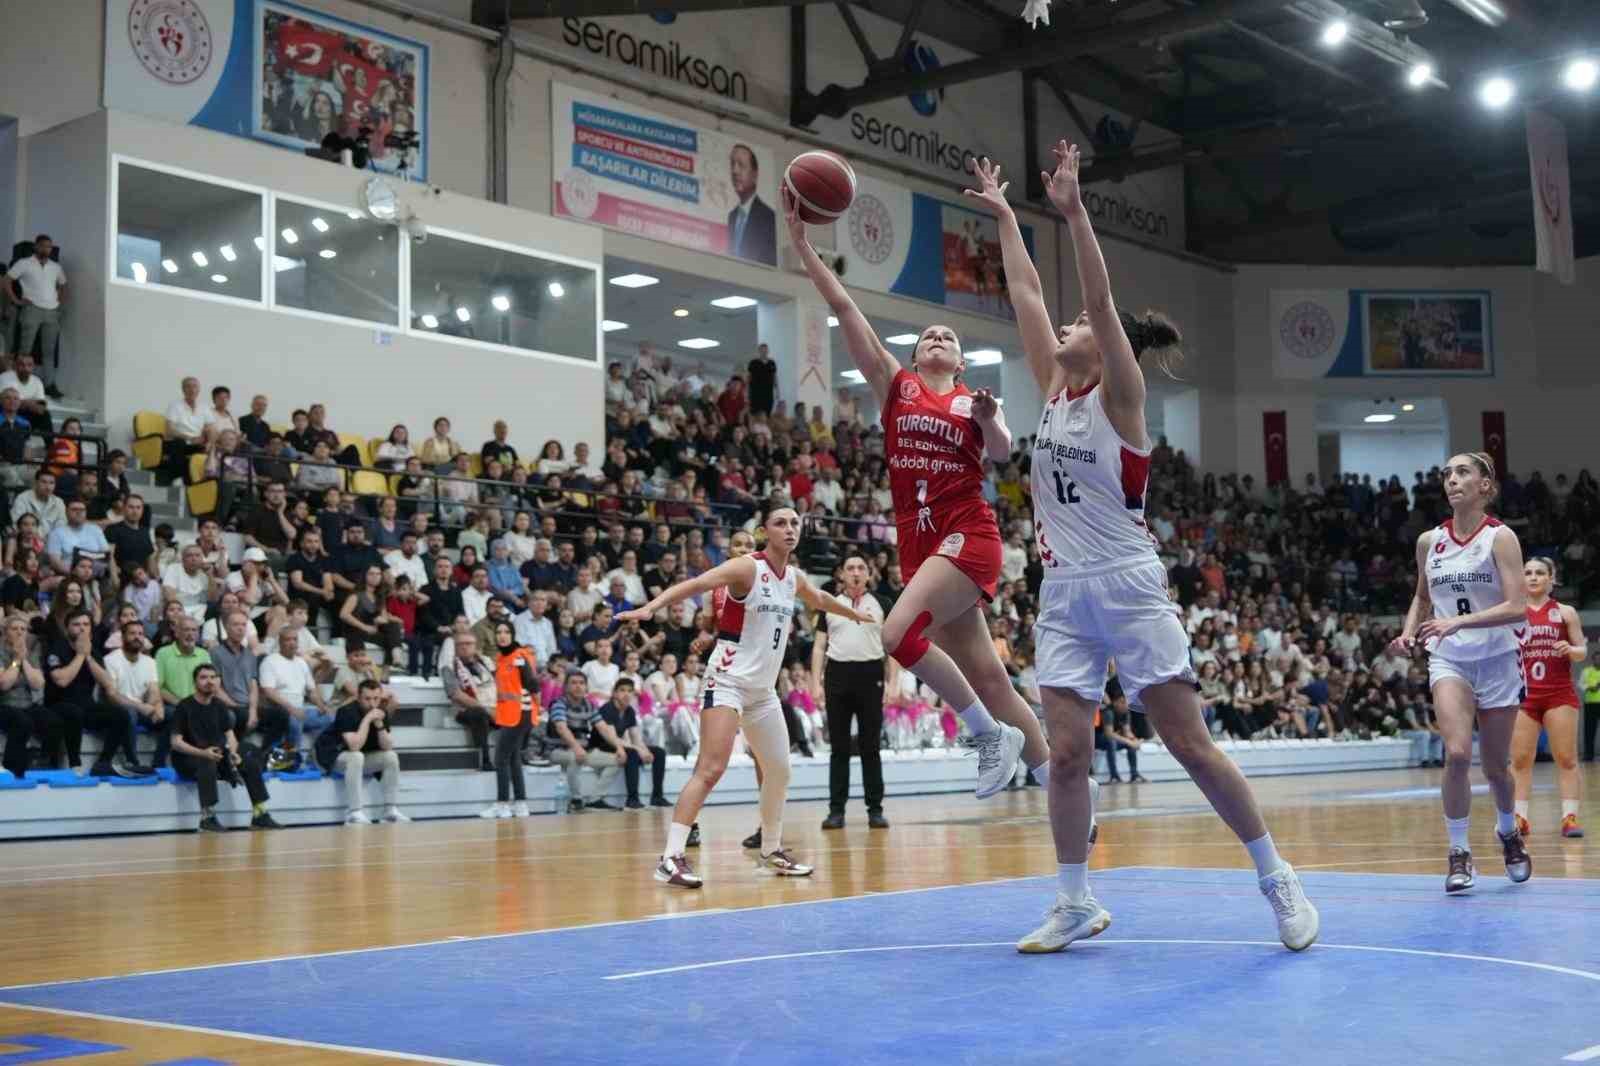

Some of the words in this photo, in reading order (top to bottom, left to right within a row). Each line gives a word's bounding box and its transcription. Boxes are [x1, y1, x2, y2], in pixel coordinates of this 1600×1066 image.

[562, 16, 748, 103] seramiksan
[580, 149, 649, 181] BAŞARILAR
[650, 169, 698, 196] DİLERİM
[896, 414, 964, 447] TURGUTLU
[1056, 442, 1097, 465] BELEDİYESİ
[1052, 470, 1081, 505] 12
[772, 627, 782, 650] 9
[1531, 661, 1546, 681] 0
